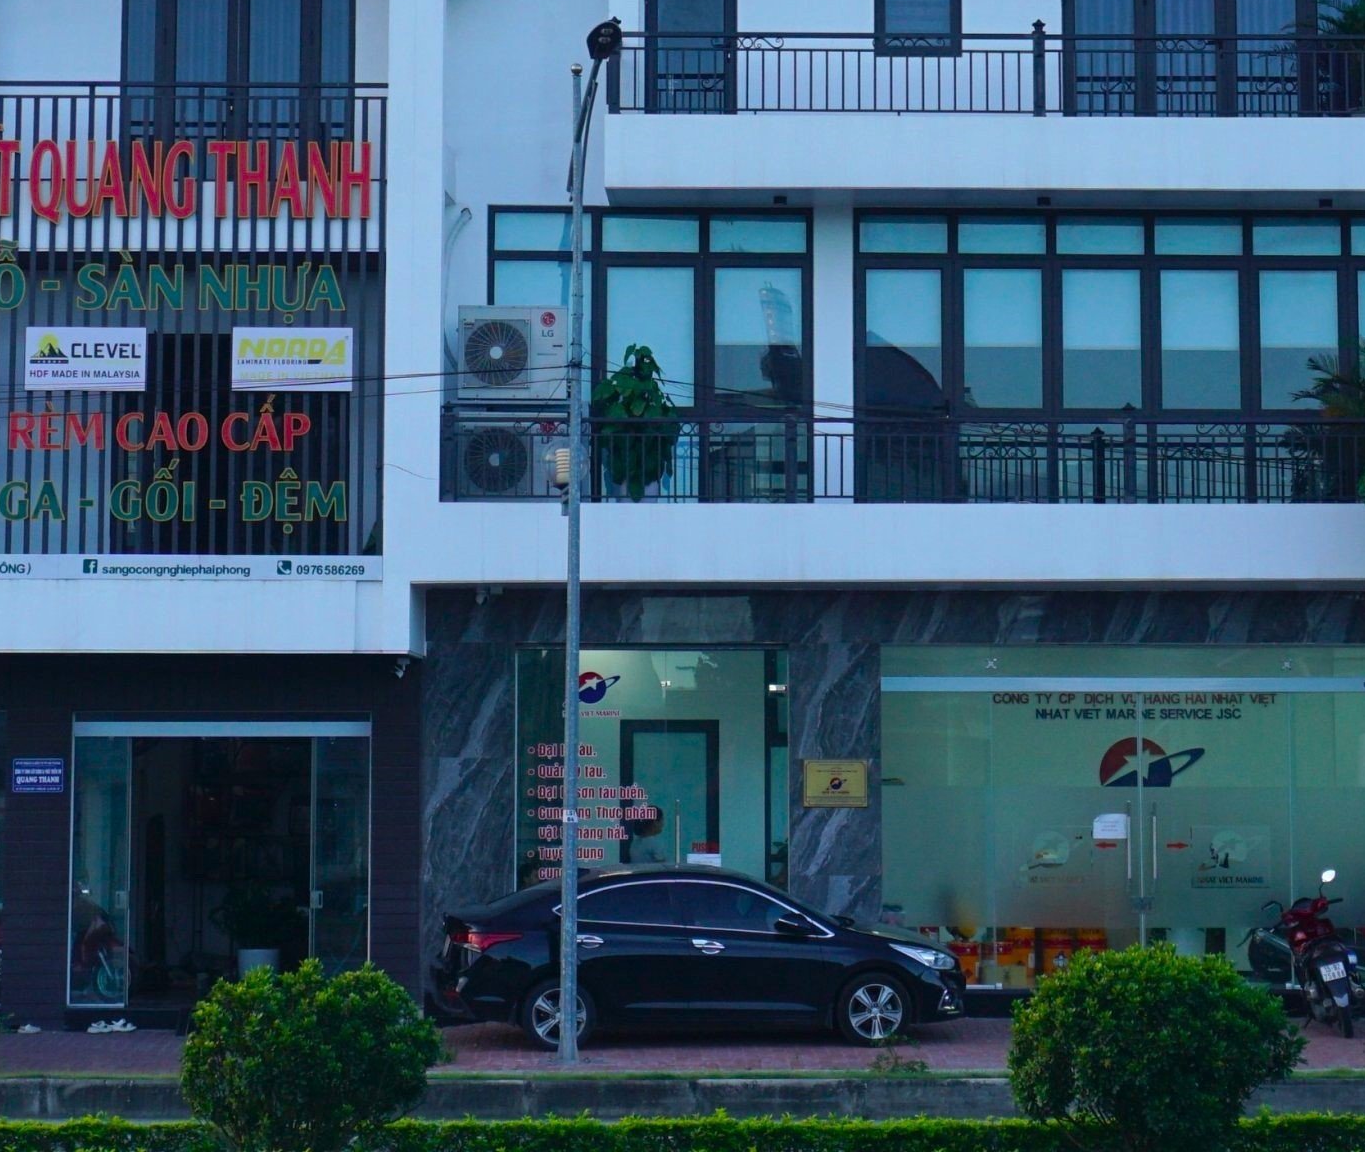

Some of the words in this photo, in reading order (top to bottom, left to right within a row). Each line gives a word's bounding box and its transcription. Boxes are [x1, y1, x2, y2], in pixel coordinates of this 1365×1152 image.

[29, 139, 196, 225] QUANG
[207, 140, 372, 219] THANH
[76, 249, 184, 311] SÀN
[198, 261, 346, 325] NHỰA
[541, 329, 555, 338] LG
[70, 343, 142, 359] CLEVEL
[29, 369, 49, 379] HDF
[51, 369, 78, 379] MADE
[81, 369, 91, 379] IN
[93, 369, 141, 379] MALAYSIA
[8, 401, 105, 451] RÈM
[115, 412, 209, 452] CAO
[221, 394, 311, 452] CẤP
[109, 458, 196, 522] GỐI
[240, 467, 348, 535] ĐỆM
[101, 564, 251, 577] sangocongnghiephaiphong
[296, 564, 365, 576] 0976586269
[1036, 693, 1053, 705] TY
[1058, 693, 1076, 705] CP
[1084, 693, 1114, 708] DỊCH
[1035, 708, 1070, 720] NHAT
[1075, 708, 1101, 720] VIET
[1106, 708, 1156, 720] MARNE
[1159, 708, 1213, 720] SERVICE
[1216, 708, 1242, 720] JSC
[596, 806, 623, 822] Thực
[625, 802, 657, 821] phẩm
